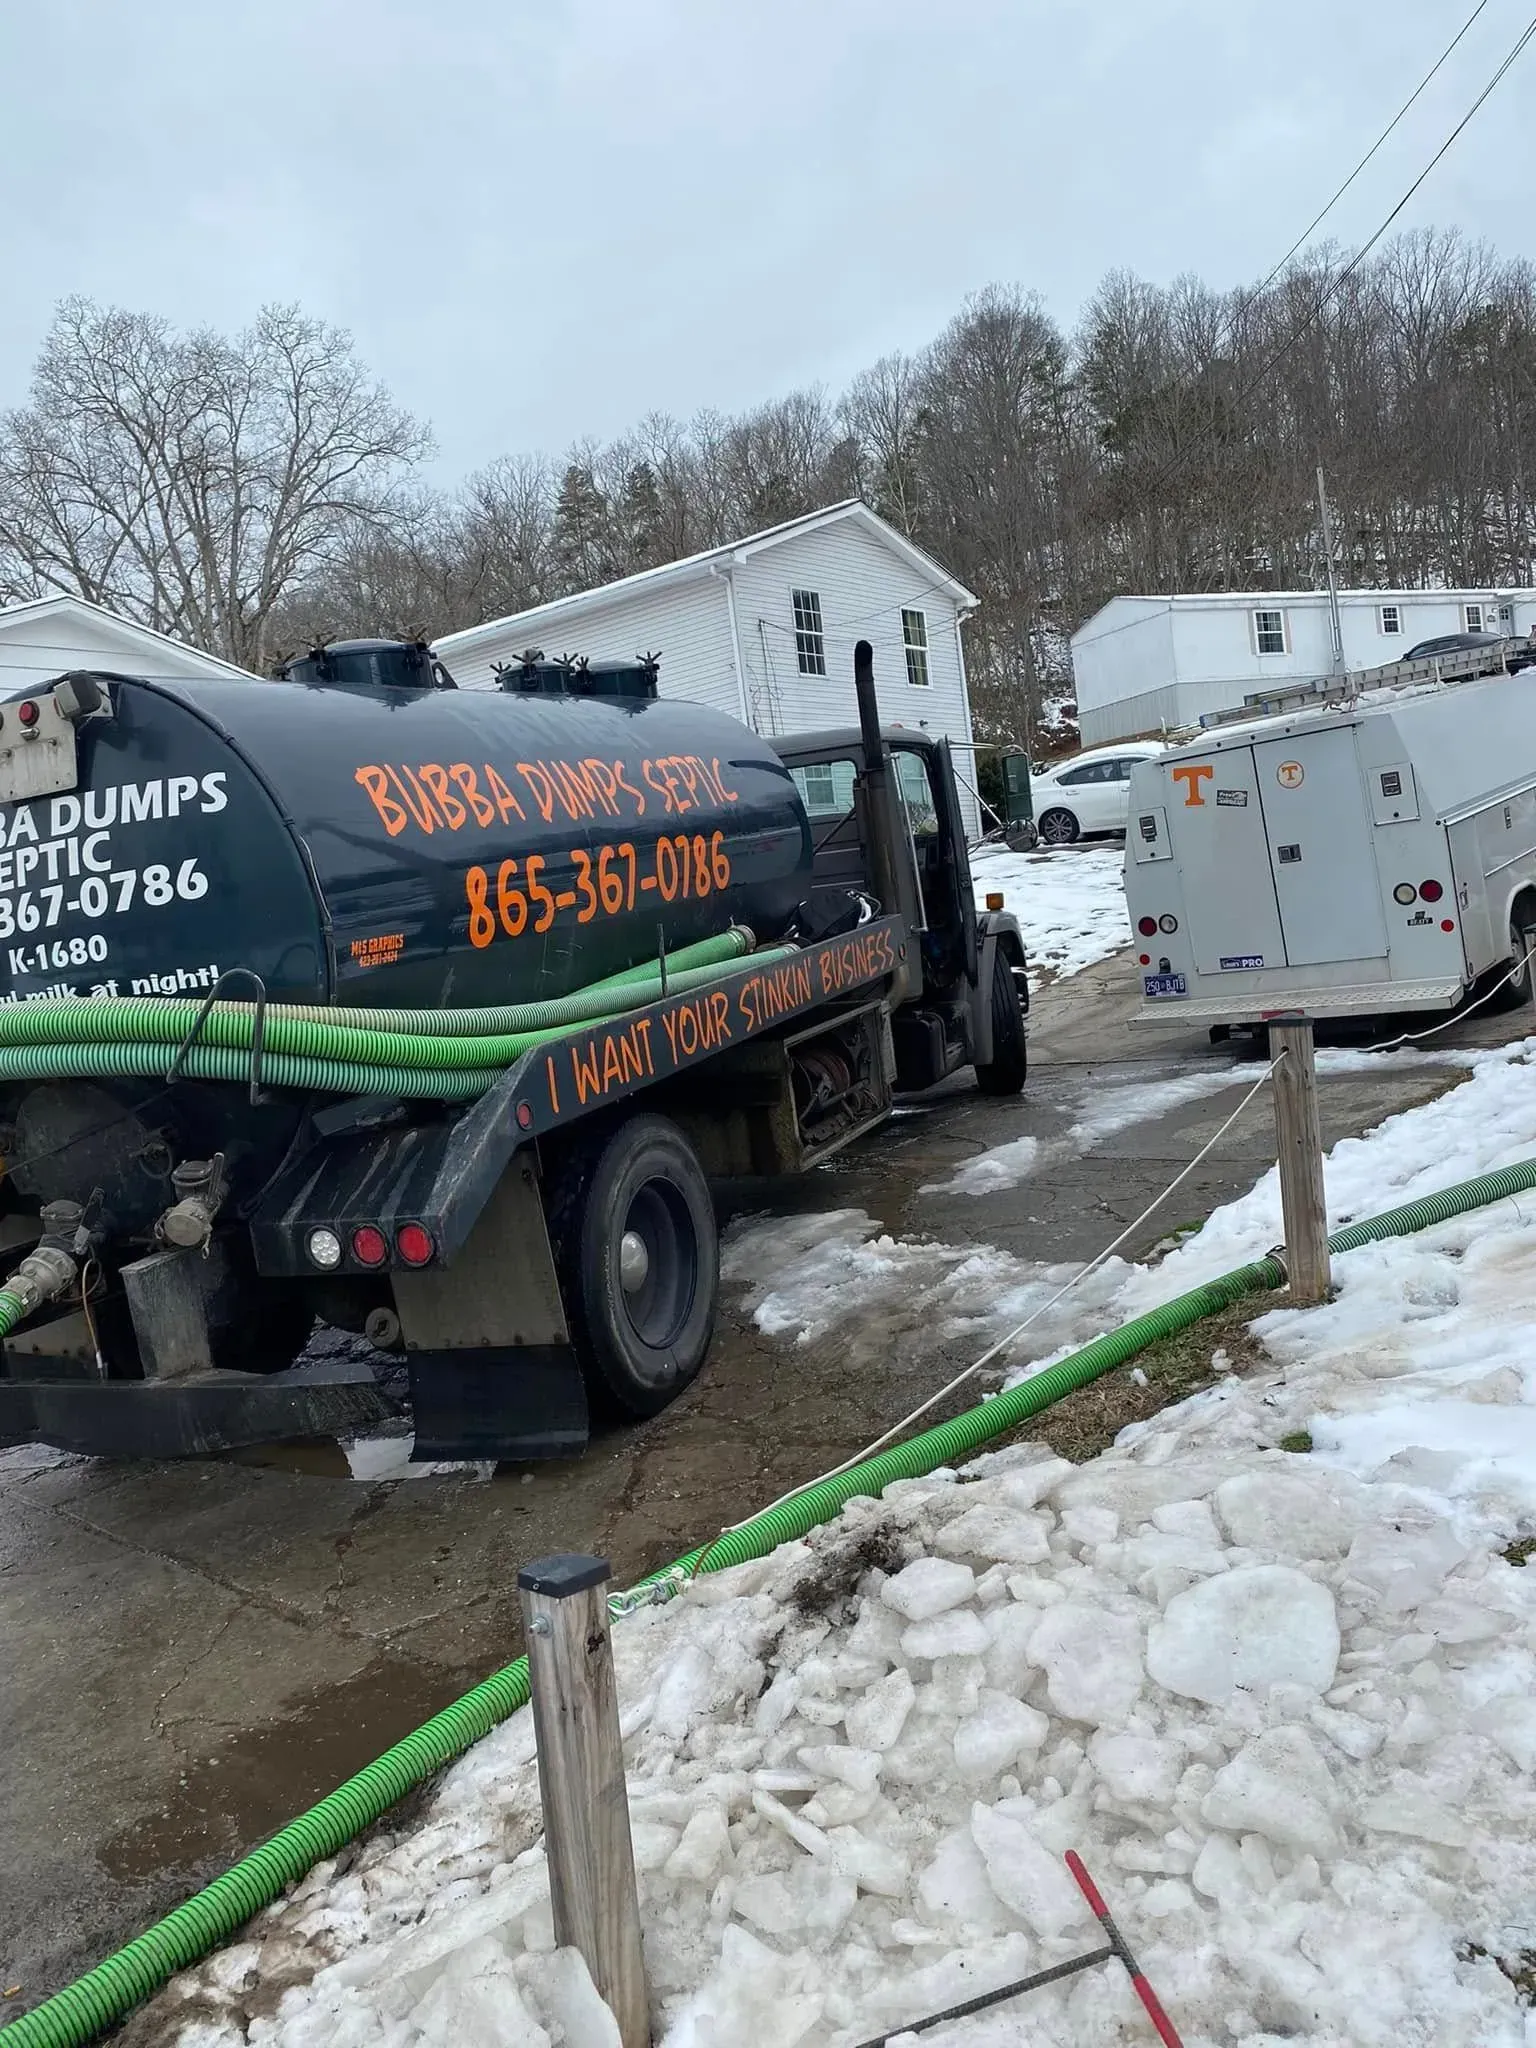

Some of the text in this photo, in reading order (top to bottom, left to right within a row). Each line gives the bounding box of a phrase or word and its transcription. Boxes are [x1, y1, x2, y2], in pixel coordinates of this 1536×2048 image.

[1173, 765, 1213, 806] T
[1281, 765, 1298, 781] T
[50, 771, 229, 837] DUMPS
[355, 755, 739, 836] BUBBA DUMPS SEPTIC
[465, 830, 730, 949] 865-367-0786
[8, 934, 108, 975] K-1680
[368, 933, 404, 953] GRAPHICS
[1242, 958, 1263, 968] PRO
[90, 979, 119, 998] at
[131, 964, 219, 995] night!
[546, 927, 894, 1113] I WANT YOUR STINKIN' BUSINESS
